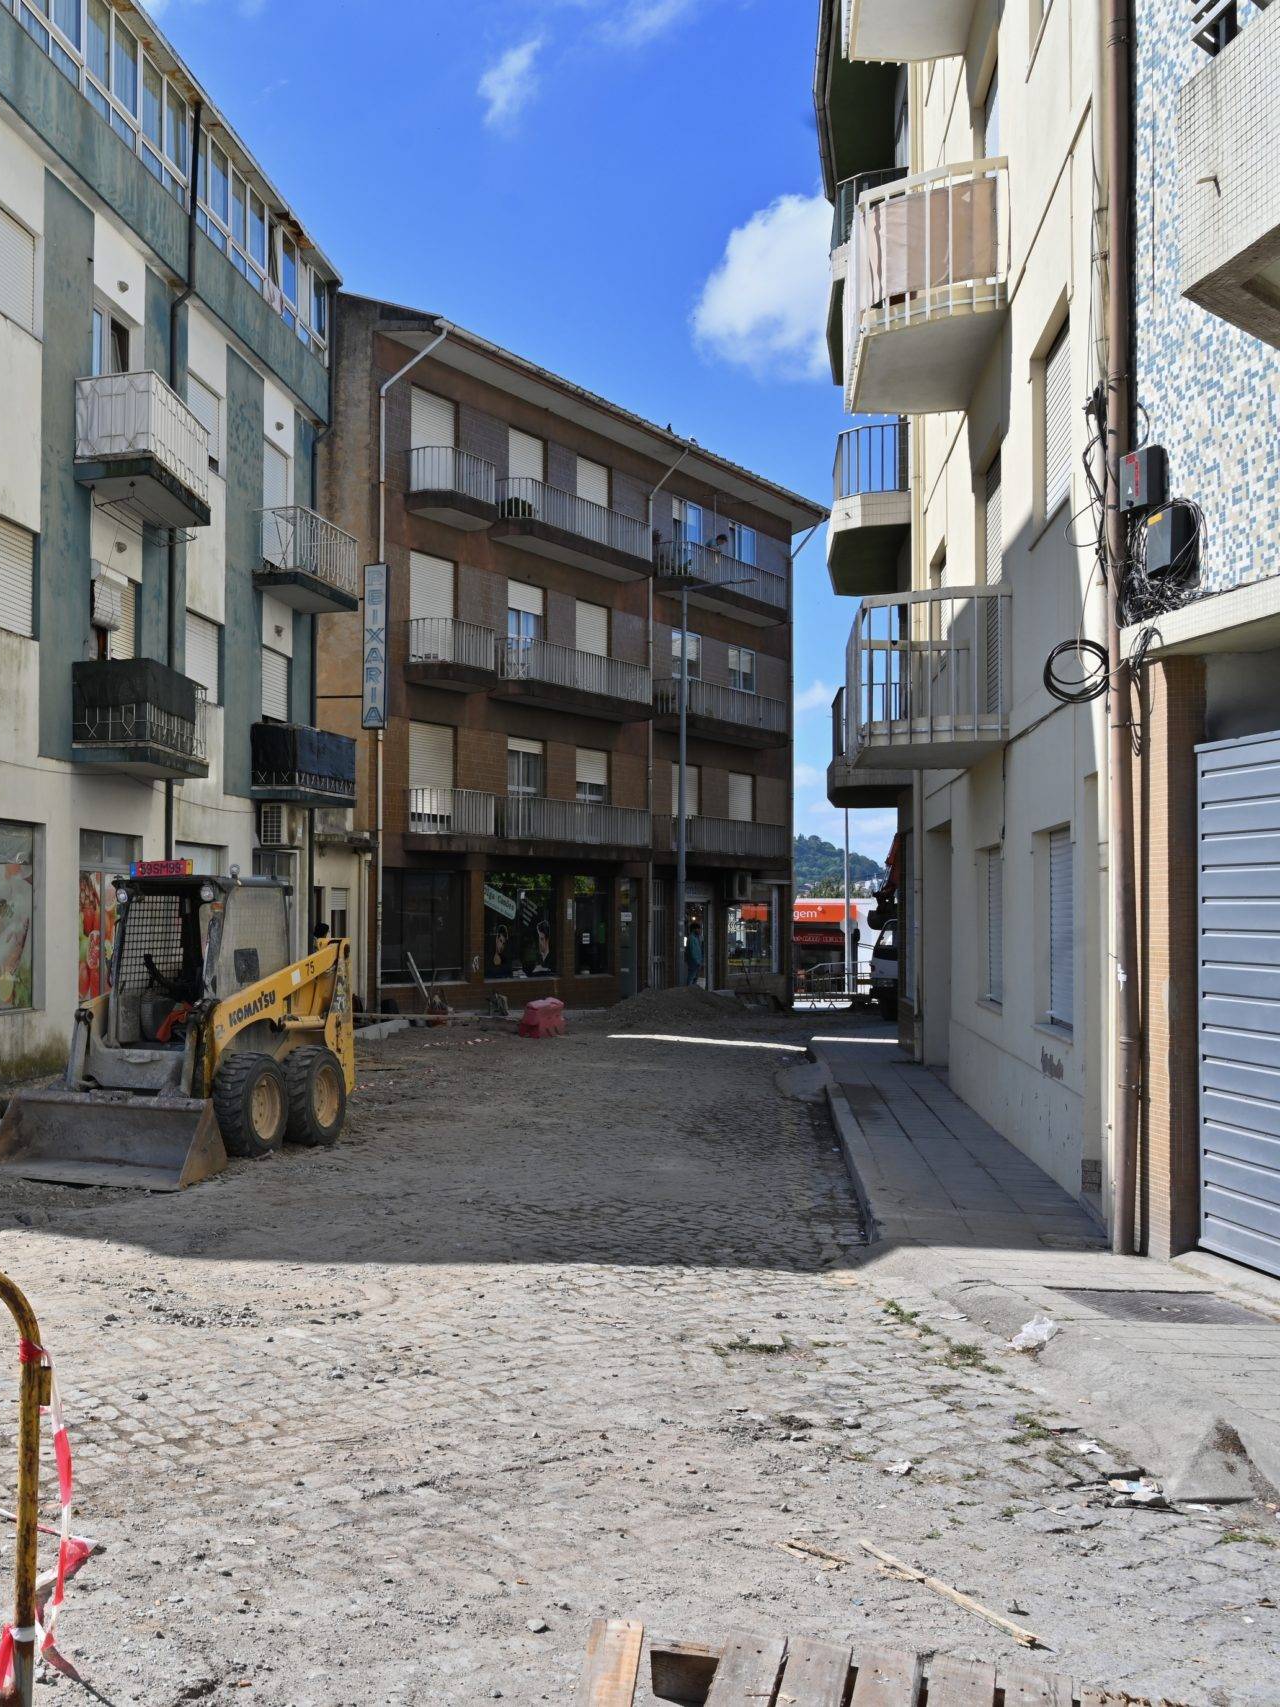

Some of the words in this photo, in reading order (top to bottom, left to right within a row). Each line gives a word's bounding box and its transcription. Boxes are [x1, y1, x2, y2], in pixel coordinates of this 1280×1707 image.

[364, 569, 384, 723] PEIXARIA
[305, 961, 315, 976] 75
[229, 989, 276, 1027] KOMATSU
